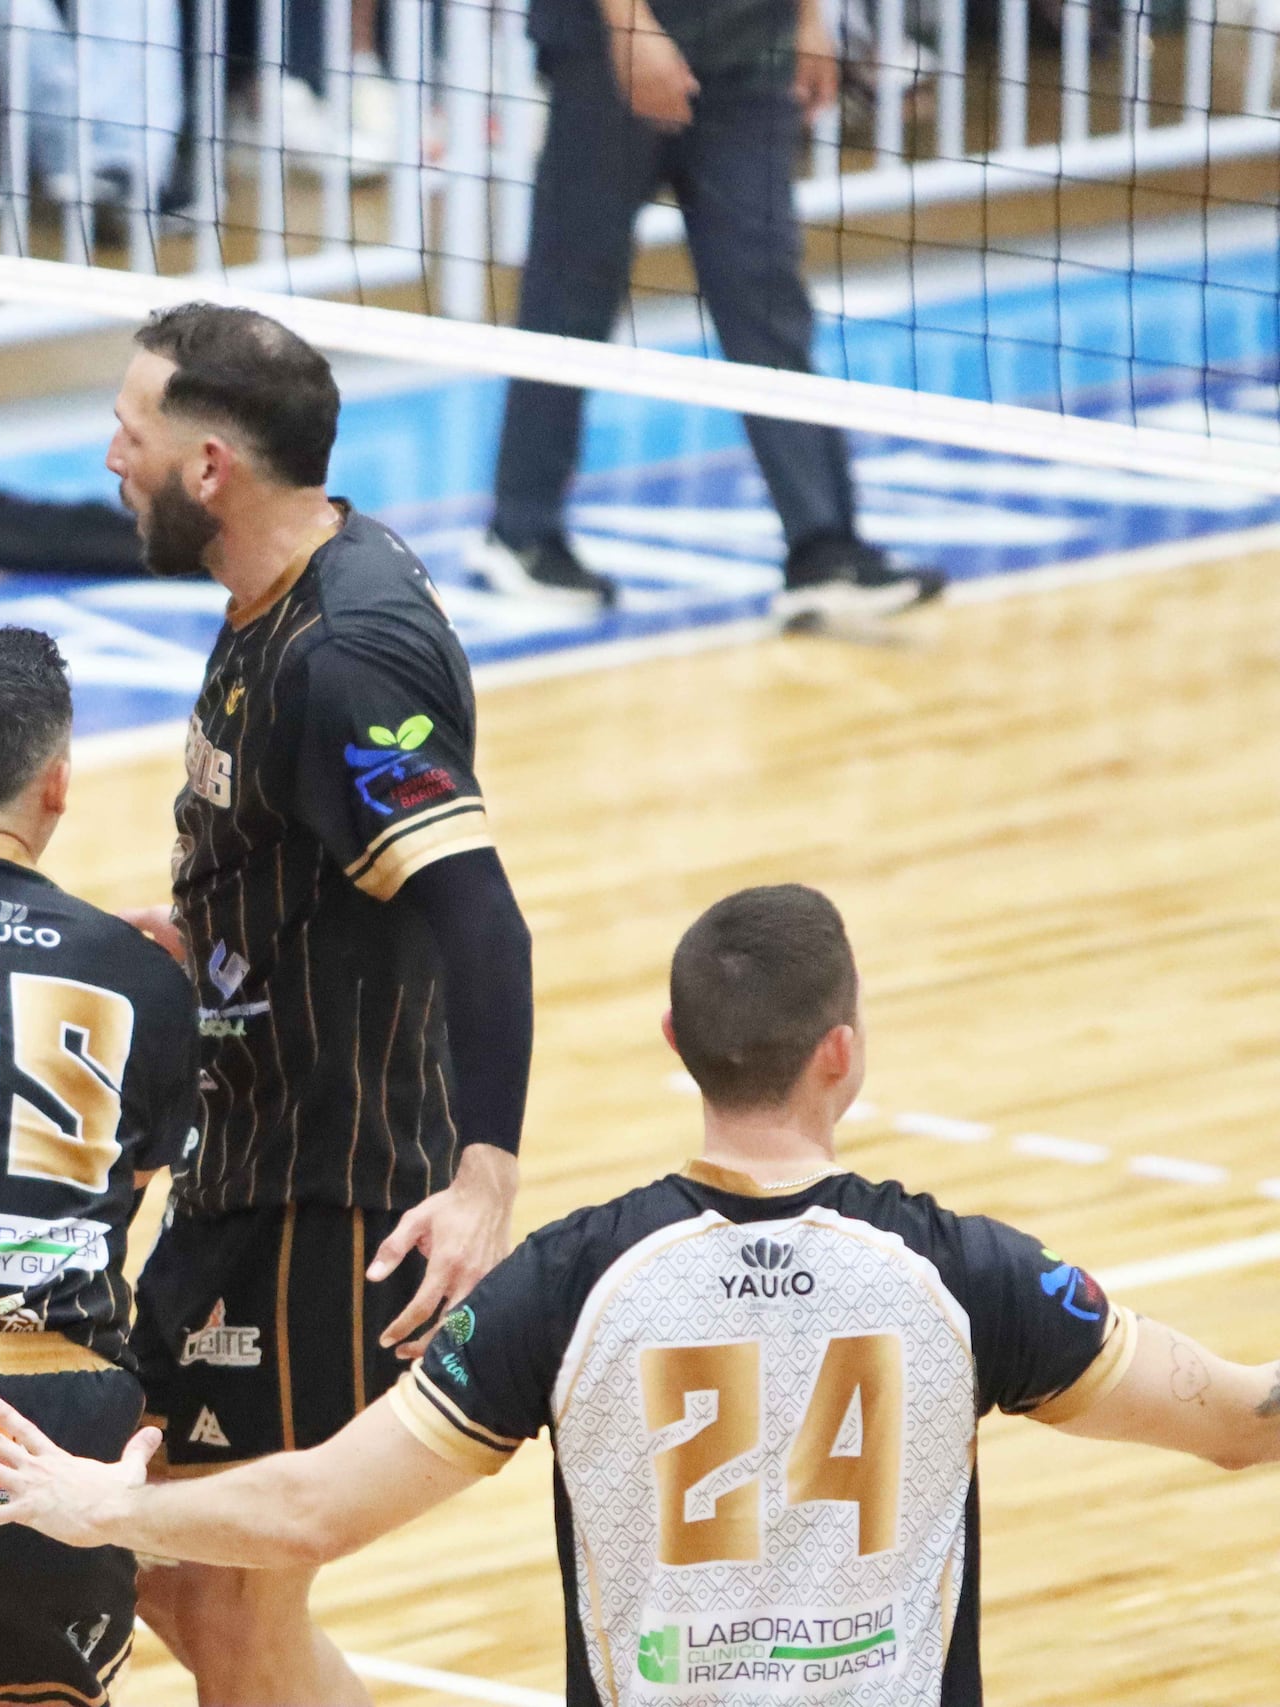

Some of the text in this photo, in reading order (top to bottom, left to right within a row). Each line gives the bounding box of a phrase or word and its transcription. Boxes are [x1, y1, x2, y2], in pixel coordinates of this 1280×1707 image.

[719, 1271, 815, 1299] YAUCO
[641, 1334, 904, 1566] 24
[688, 1603, 894, 1648] LABORATORIO
[687, 1644, 766, 1664] CLINICO
[687, 1644, 897, 1684] IRIZARRY GUASCH
